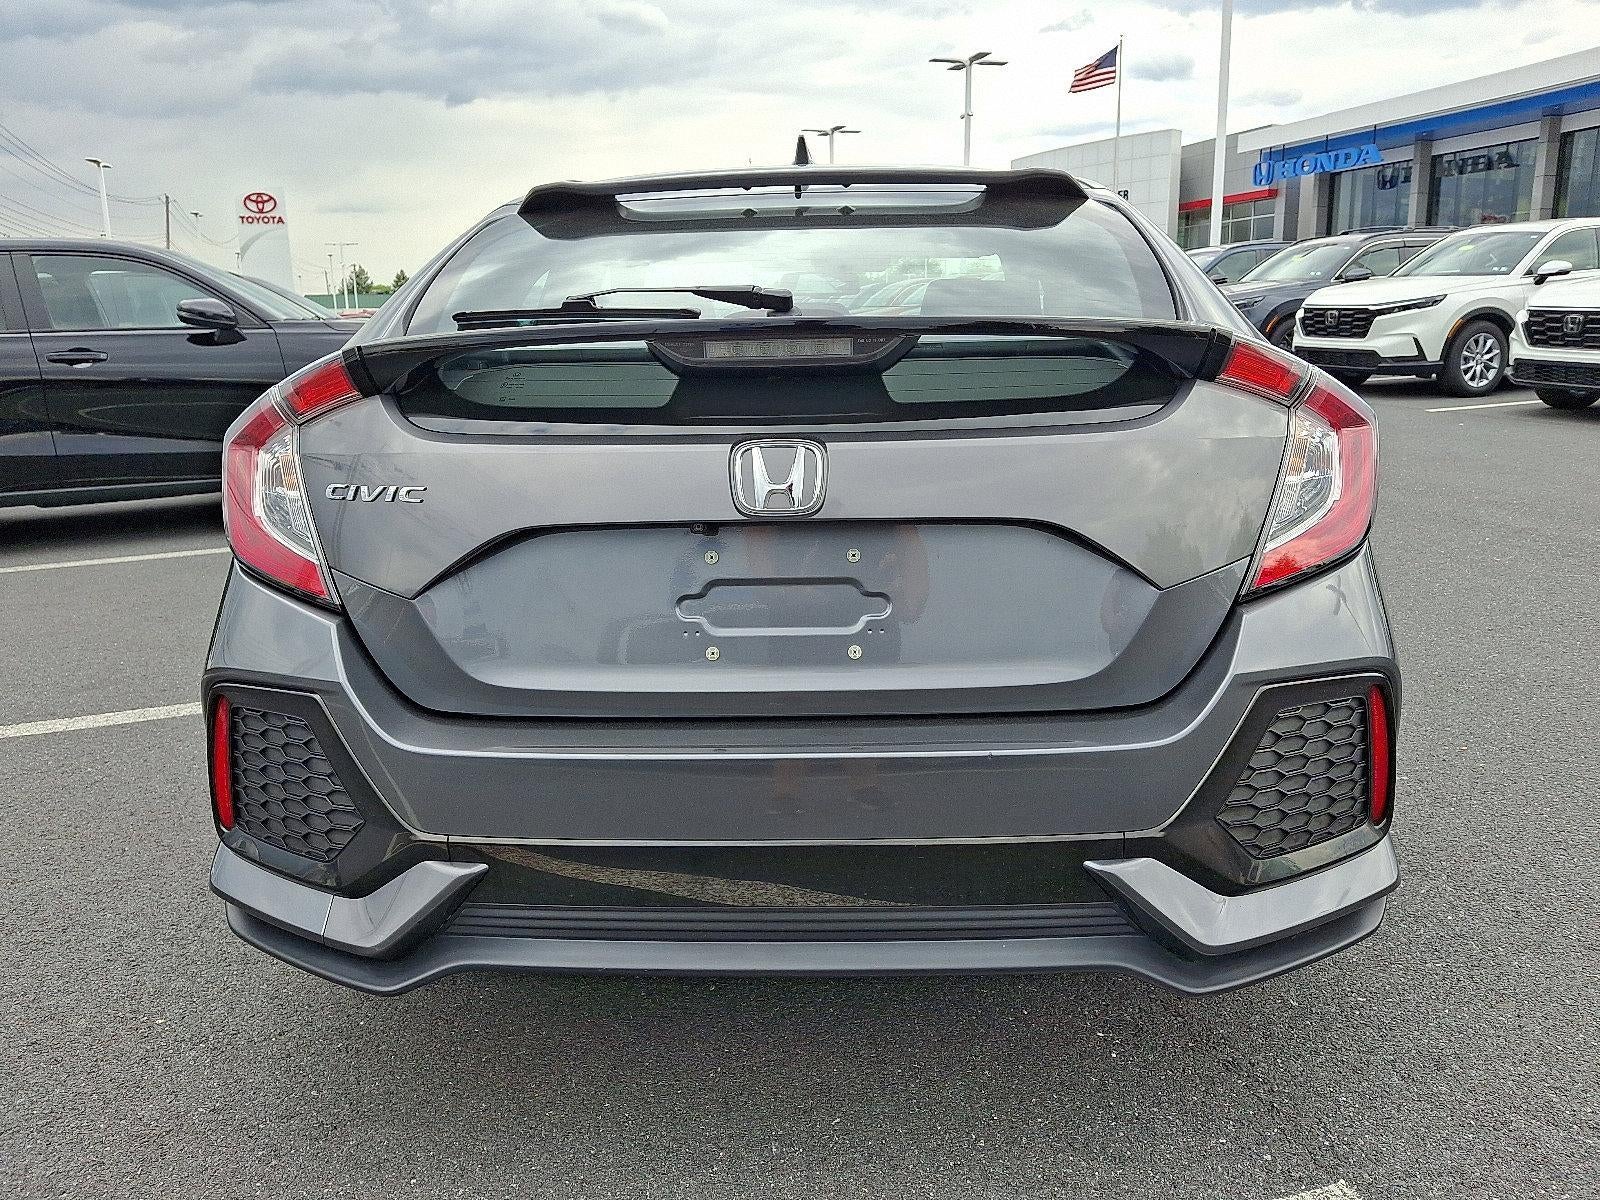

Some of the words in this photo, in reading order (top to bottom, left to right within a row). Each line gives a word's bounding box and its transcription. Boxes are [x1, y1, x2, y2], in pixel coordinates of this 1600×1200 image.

[1273, 143, 1383, 180] HONDA
[239, 215, 285, 225] TOYOTA
[325, 483, 428, 503] CIVIC
